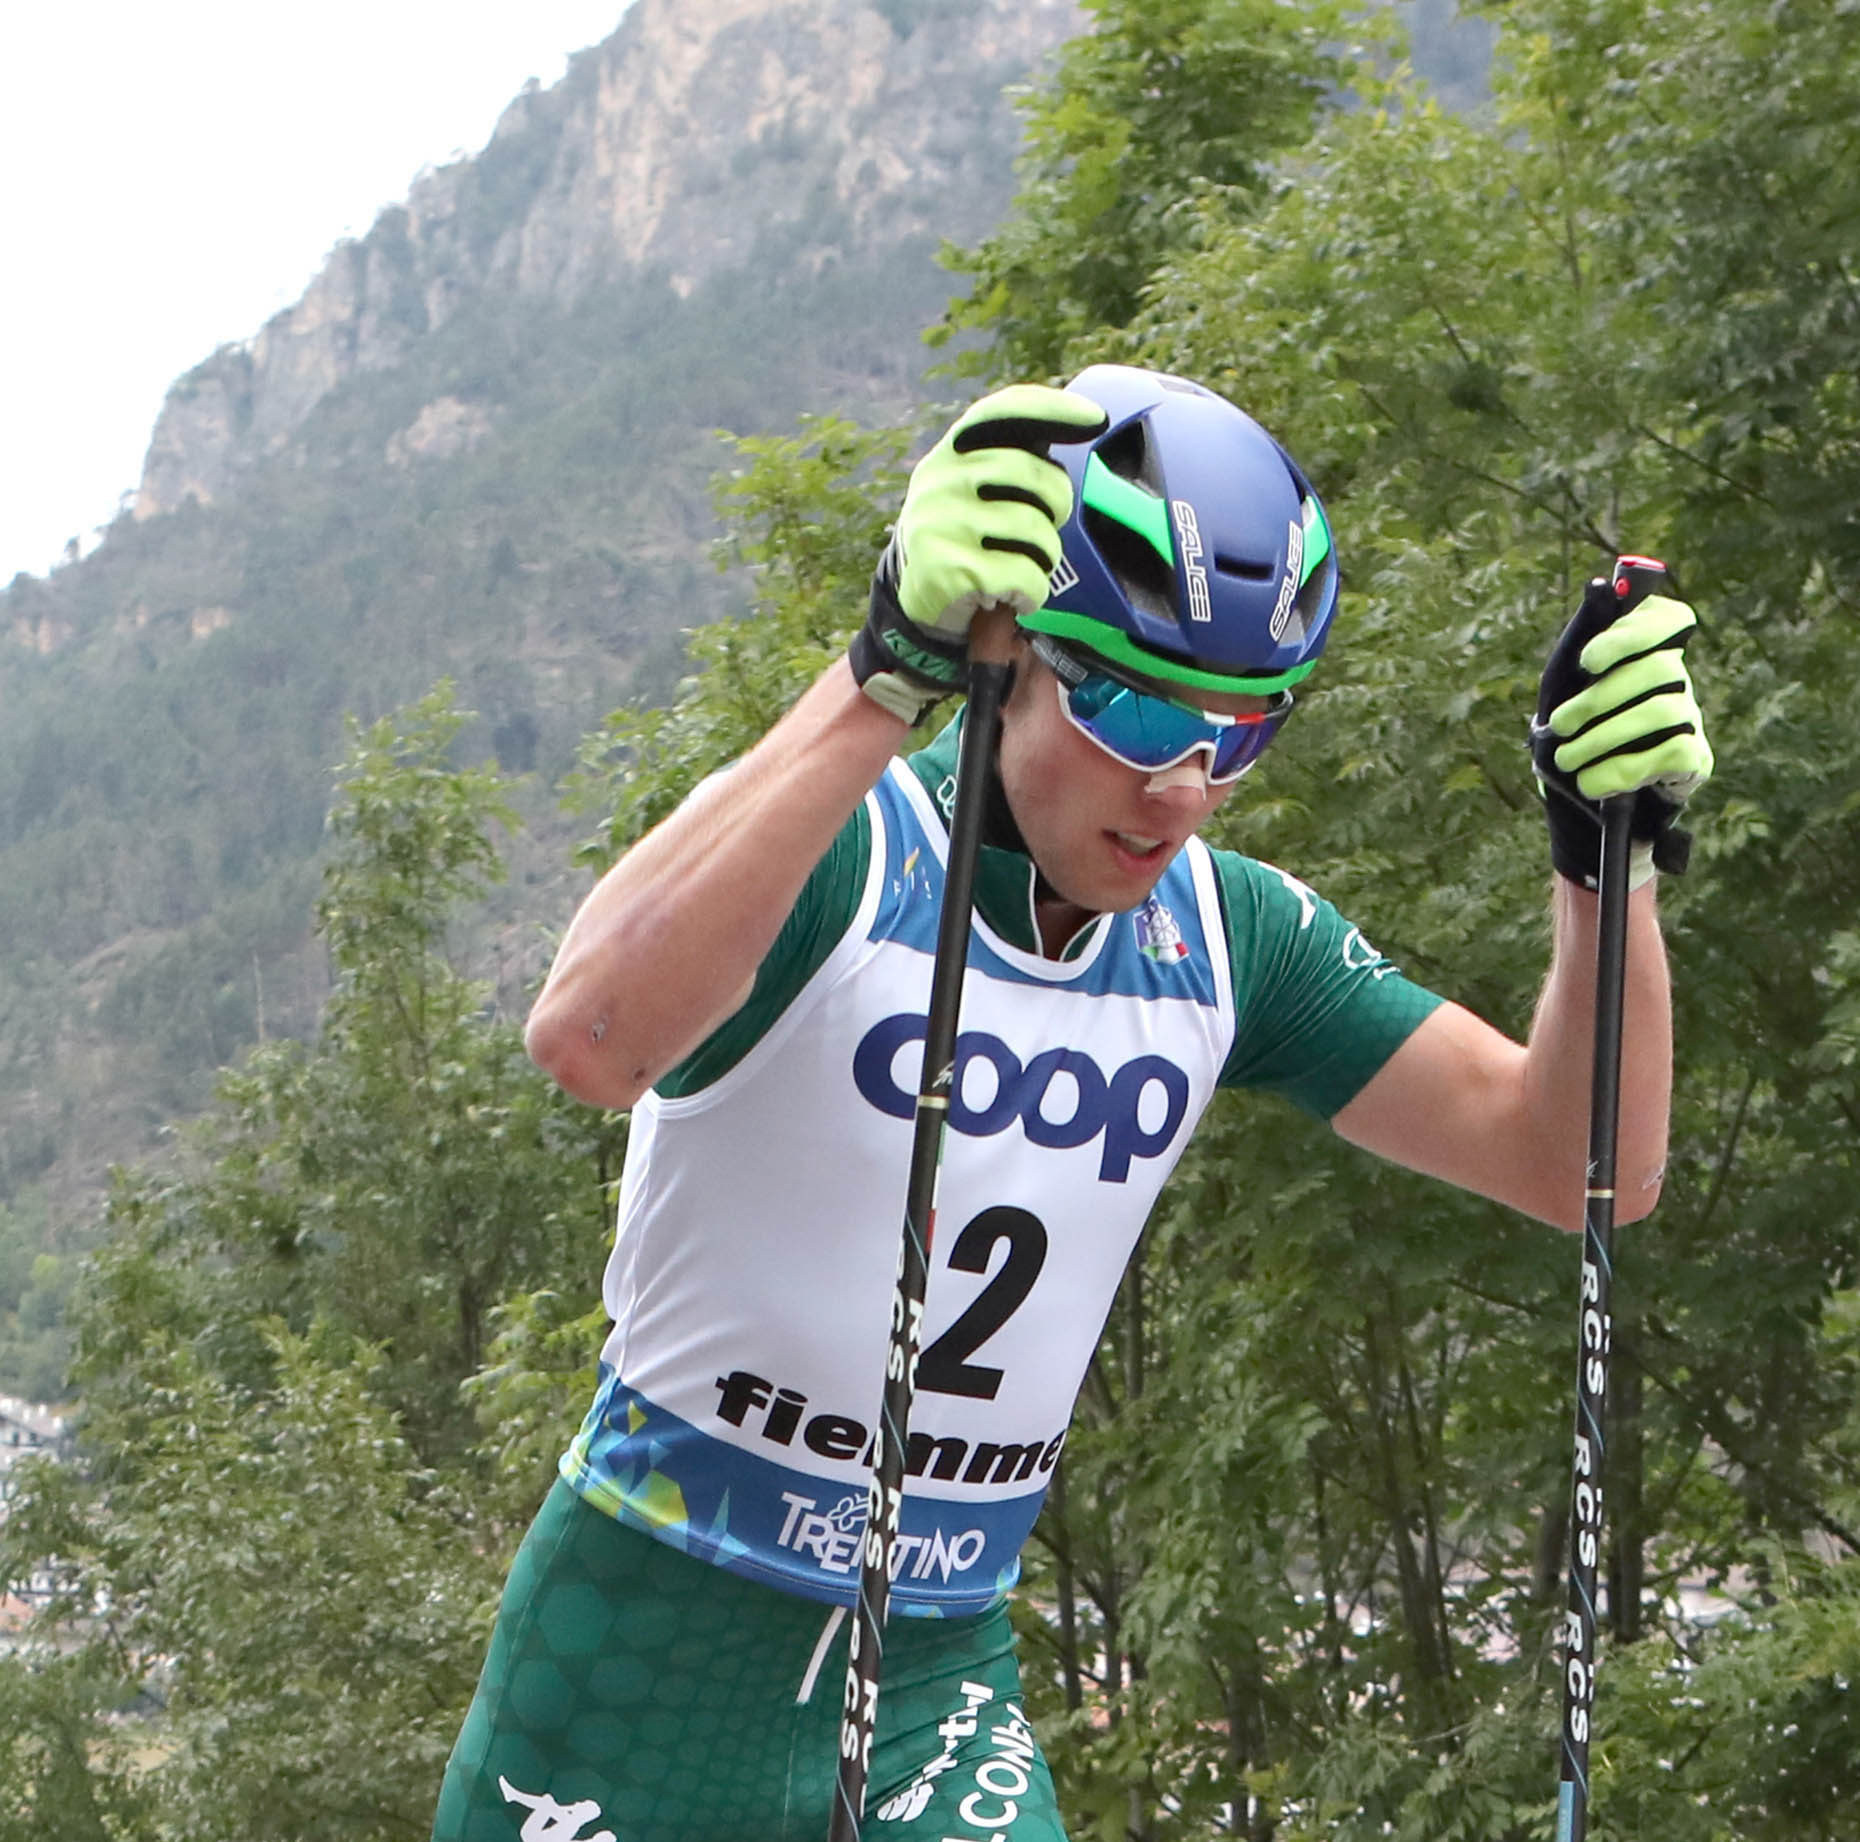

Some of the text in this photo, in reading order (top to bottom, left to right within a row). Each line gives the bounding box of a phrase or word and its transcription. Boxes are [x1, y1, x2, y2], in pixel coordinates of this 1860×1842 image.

[1172, 499, 1212, 622] SALICE
[1269, 520, 1304, 642] SALICE
[852, 1012, 1189, 1184] coop
[912, 1205, 1048, 1401] 2
[1582, 1260, 1605, 1396] RCS
[1574, 1434, 1597, 1568] RCS
[1565, 1609, 1589, 1744] RCS
